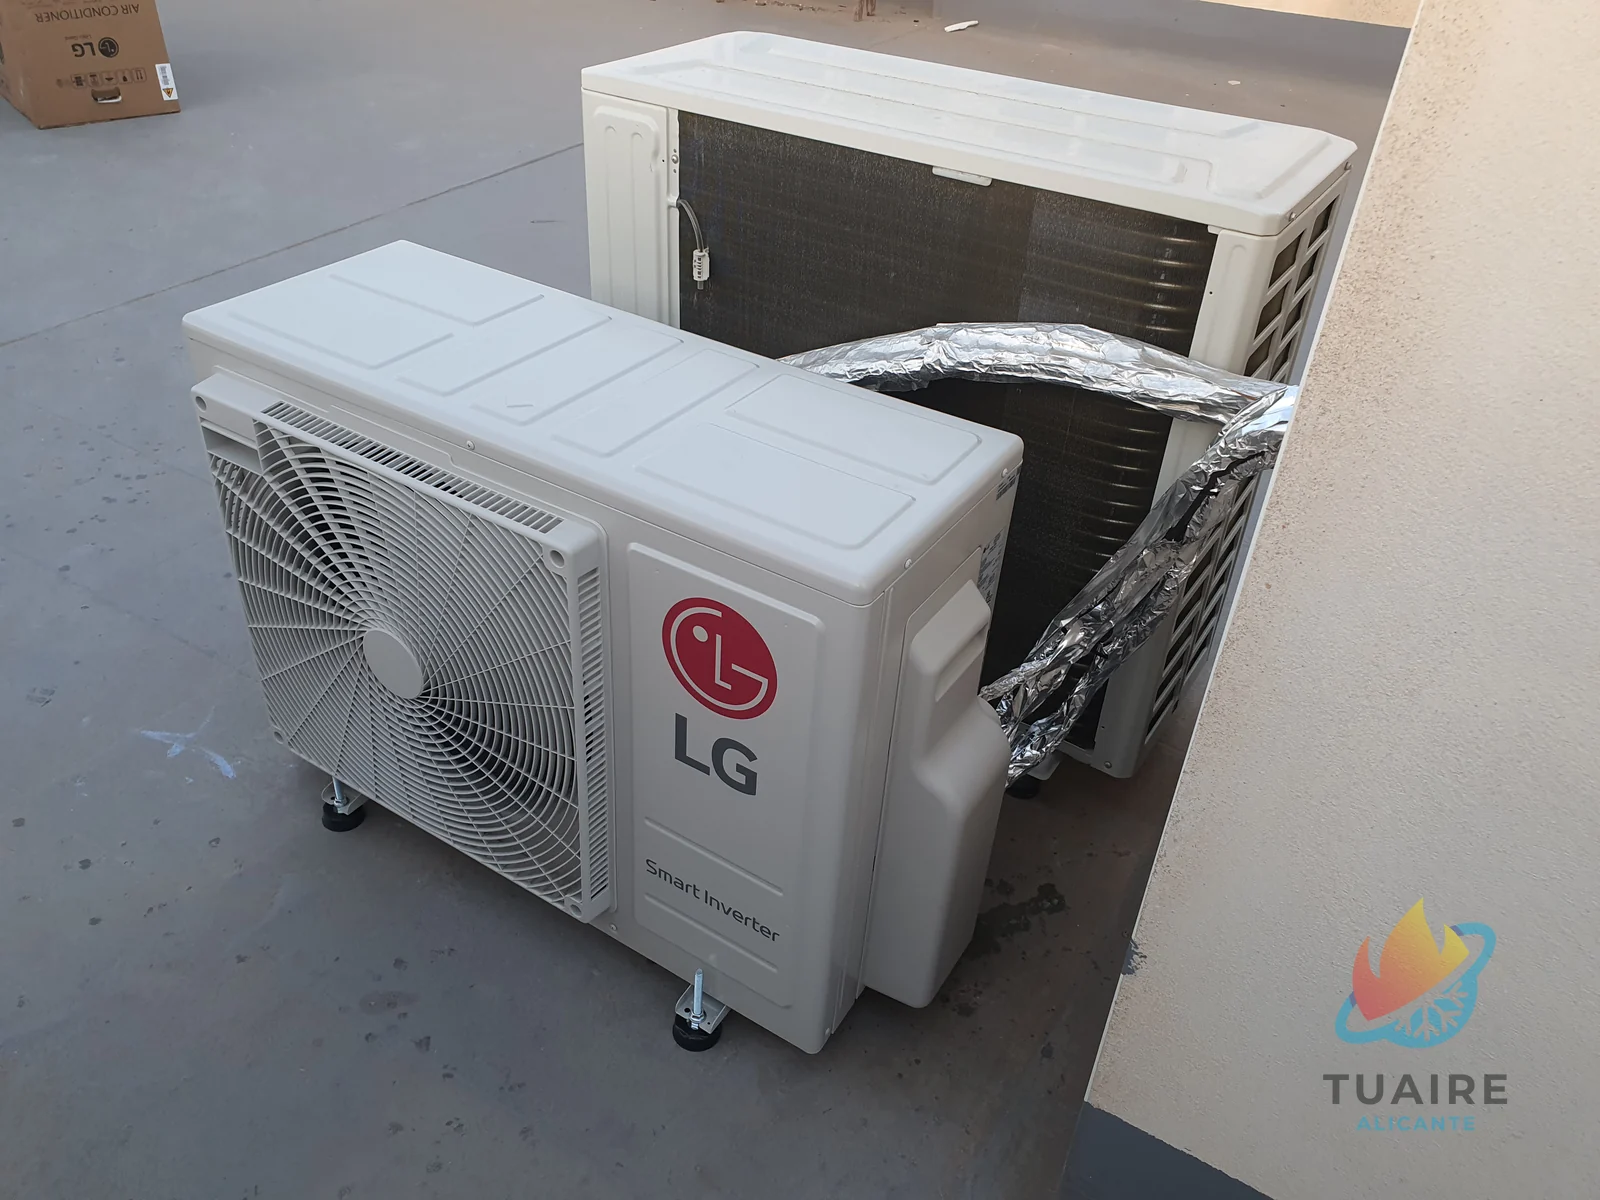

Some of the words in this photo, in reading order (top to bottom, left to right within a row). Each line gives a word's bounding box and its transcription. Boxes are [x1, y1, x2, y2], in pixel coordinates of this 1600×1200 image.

[34, 5, 119, 23] CONDITIONER
[121, 3, 140, 15] AIR
[71, 41, 96, 58] LG
[674, 712, 758, 796] LG
[645, 857, 701, 901] Smart
[704, 889, 781, 943] Inverter
